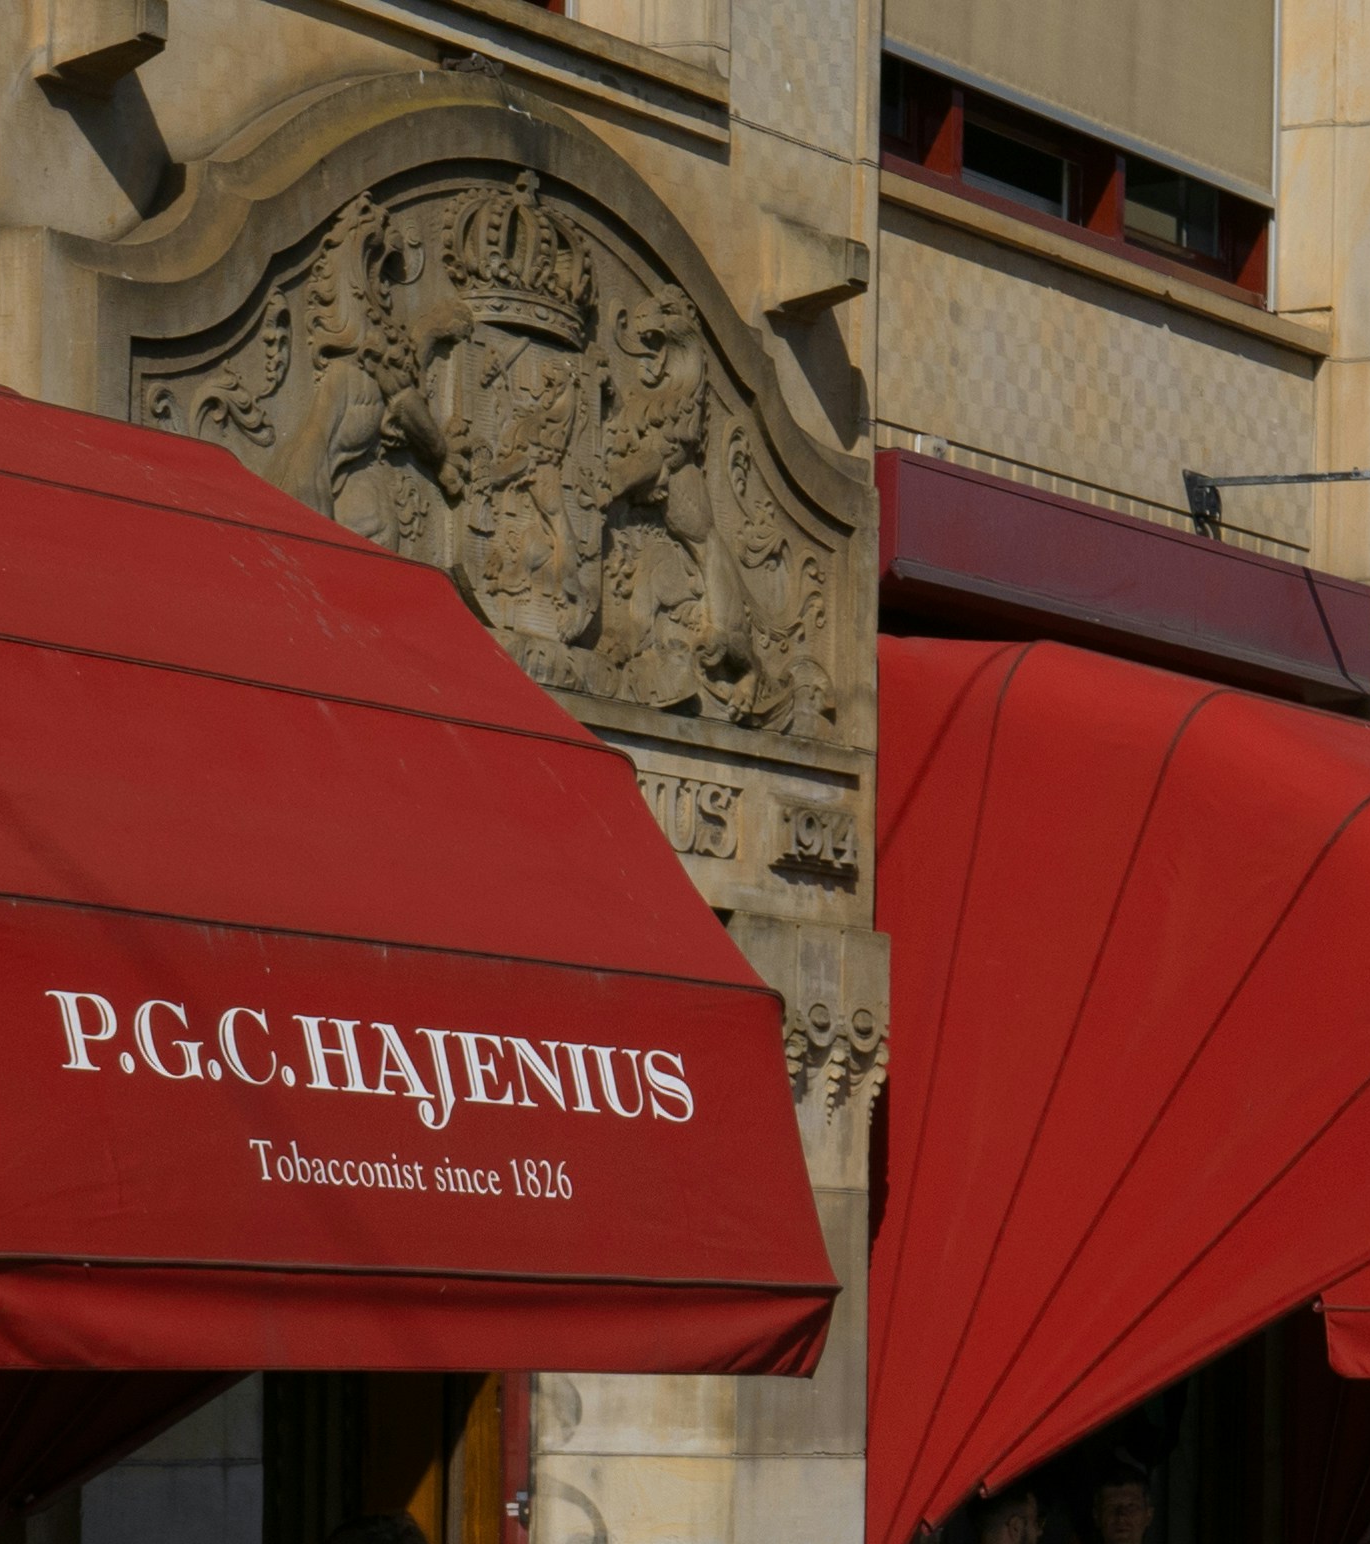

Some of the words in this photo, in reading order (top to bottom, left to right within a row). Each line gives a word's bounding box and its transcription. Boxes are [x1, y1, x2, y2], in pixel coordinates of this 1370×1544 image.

[780, 807, 857, 868] 1914
[249, 1139, 427, 1191] Tobacconist
[435, 1157, 503, 1195] since
[510, 1158, 573, 1200] 1826
